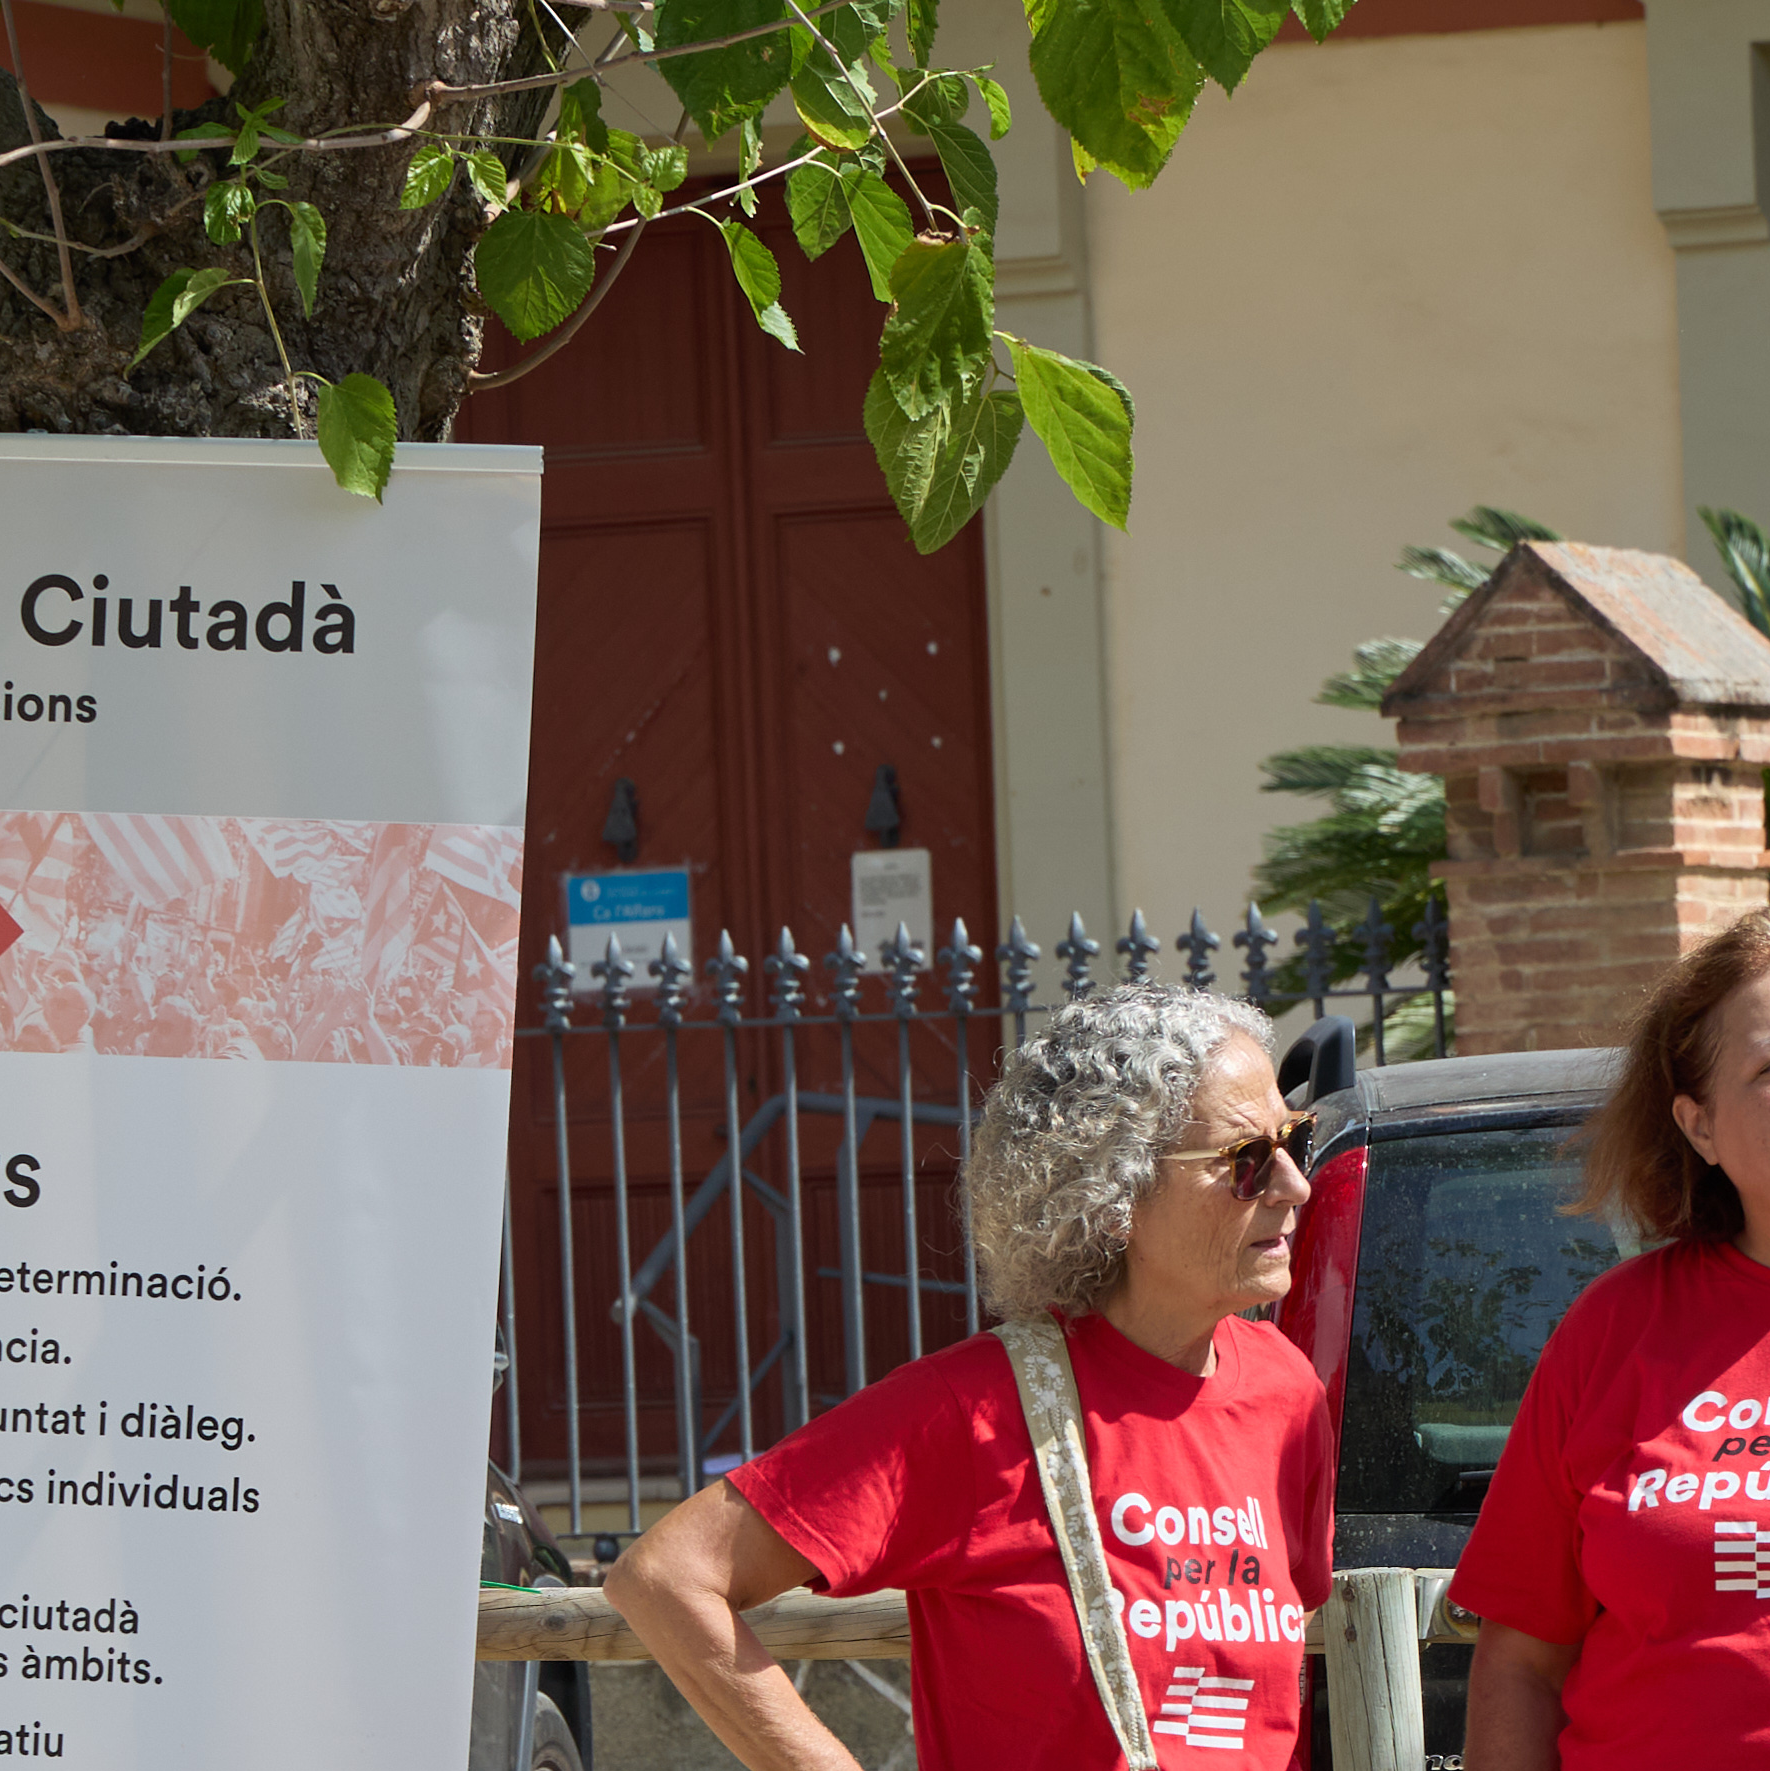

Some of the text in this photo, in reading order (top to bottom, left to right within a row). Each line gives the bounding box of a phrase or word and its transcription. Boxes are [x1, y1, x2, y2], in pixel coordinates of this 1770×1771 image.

[20, 573, 356, 655] Ciutadà
[99, 1400, 108, 1436] i
[120, 1402, 256, 1451] diàleg.
[47, 1468, 260, 1514] individuals
[1110, 1492, 1269, 1550] Consell
[1164, 1548, 1261, 1589] per la
[1110, 1587, 1306, 1652] epúblic
[21, 1644, 163, 1685] àmbits.
